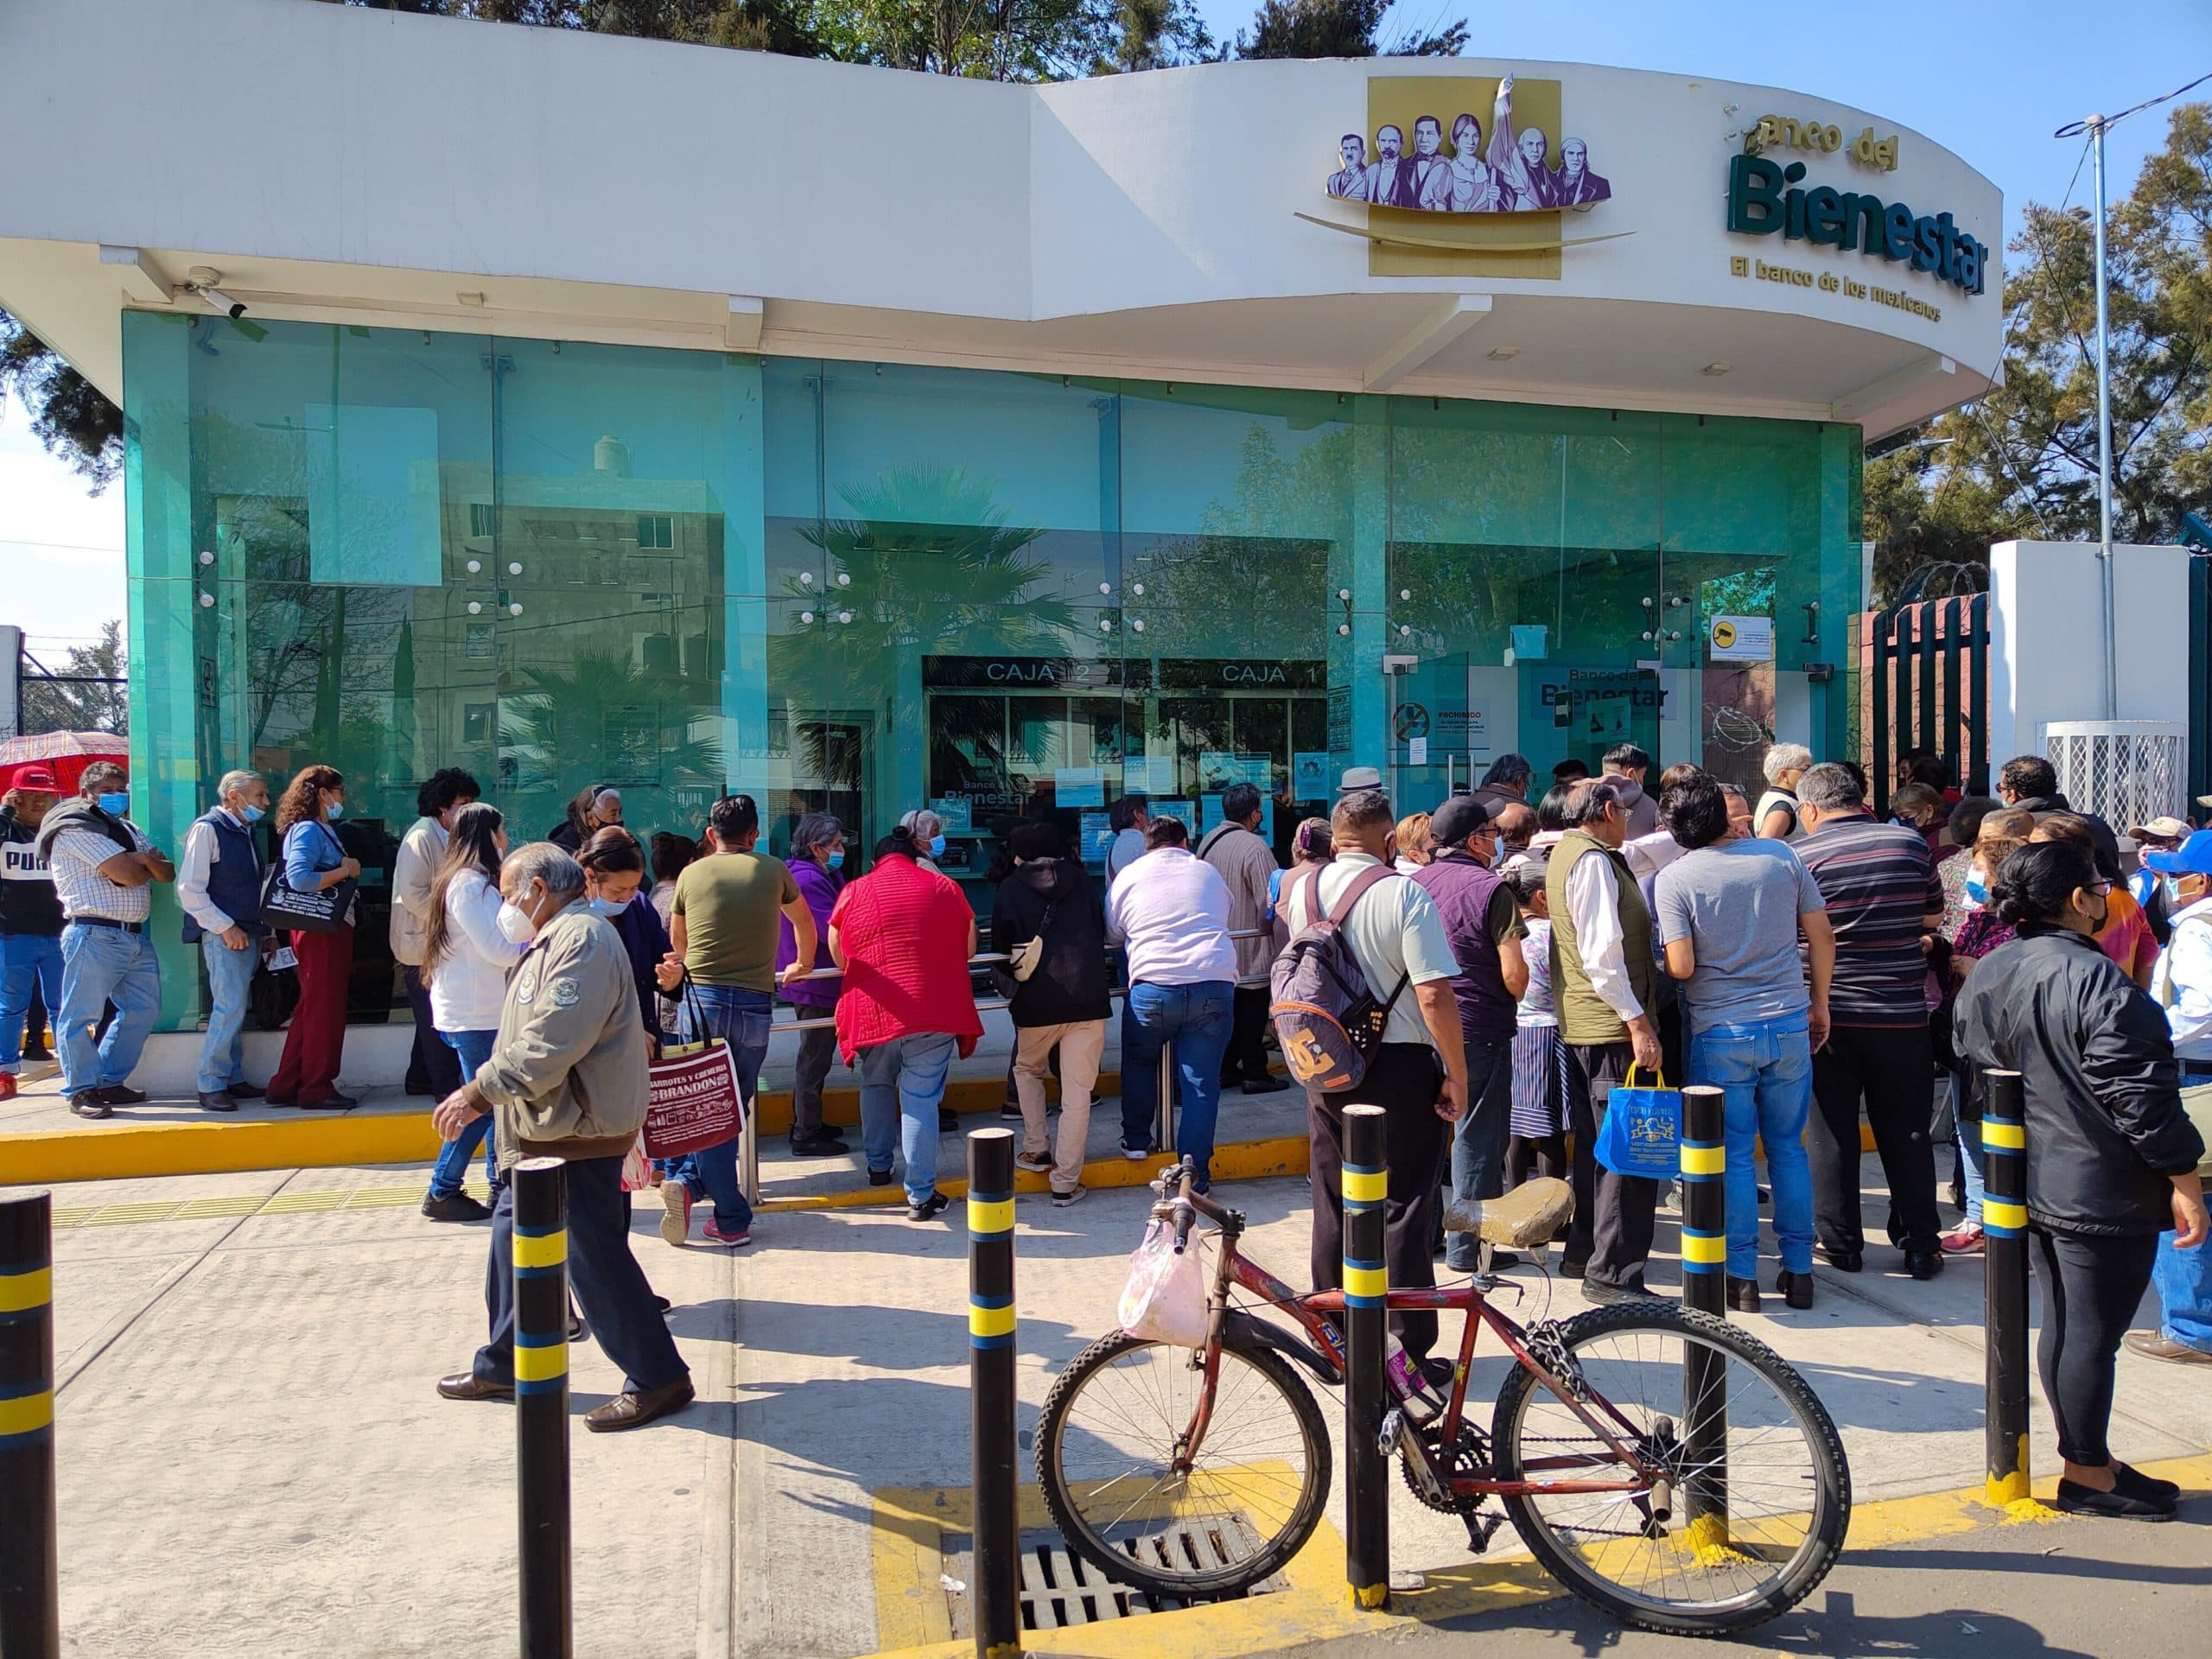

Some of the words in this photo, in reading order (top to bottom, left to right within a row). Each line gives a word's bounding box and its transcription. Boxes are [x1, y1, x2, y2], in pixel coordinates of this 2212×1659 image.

[1849, 127, 1899, 171] del
[1728, 154, 1989, 296] Bienestar
[1731, 257, 1750, 277] El
[1756, 259, 1814, 287] banco
[1819, 271, 1839, 292] de
[1844, 276, 1866, 298] los
[1871, 286, 1942, 322] mexicanos
[987, 664, 1054, 681] CAJA
[1077, 665, 1090, 681] 2
[1223, 665, 1285, 683] CAJA
[1308, 667, 1316, 683] 1
[1569, 669, 1615, 682] Banco
[1621, 670, 1639, 682] de
[963, 780, 995, 789] Banco
[659, 1077, 717, 1100] BRANDON
